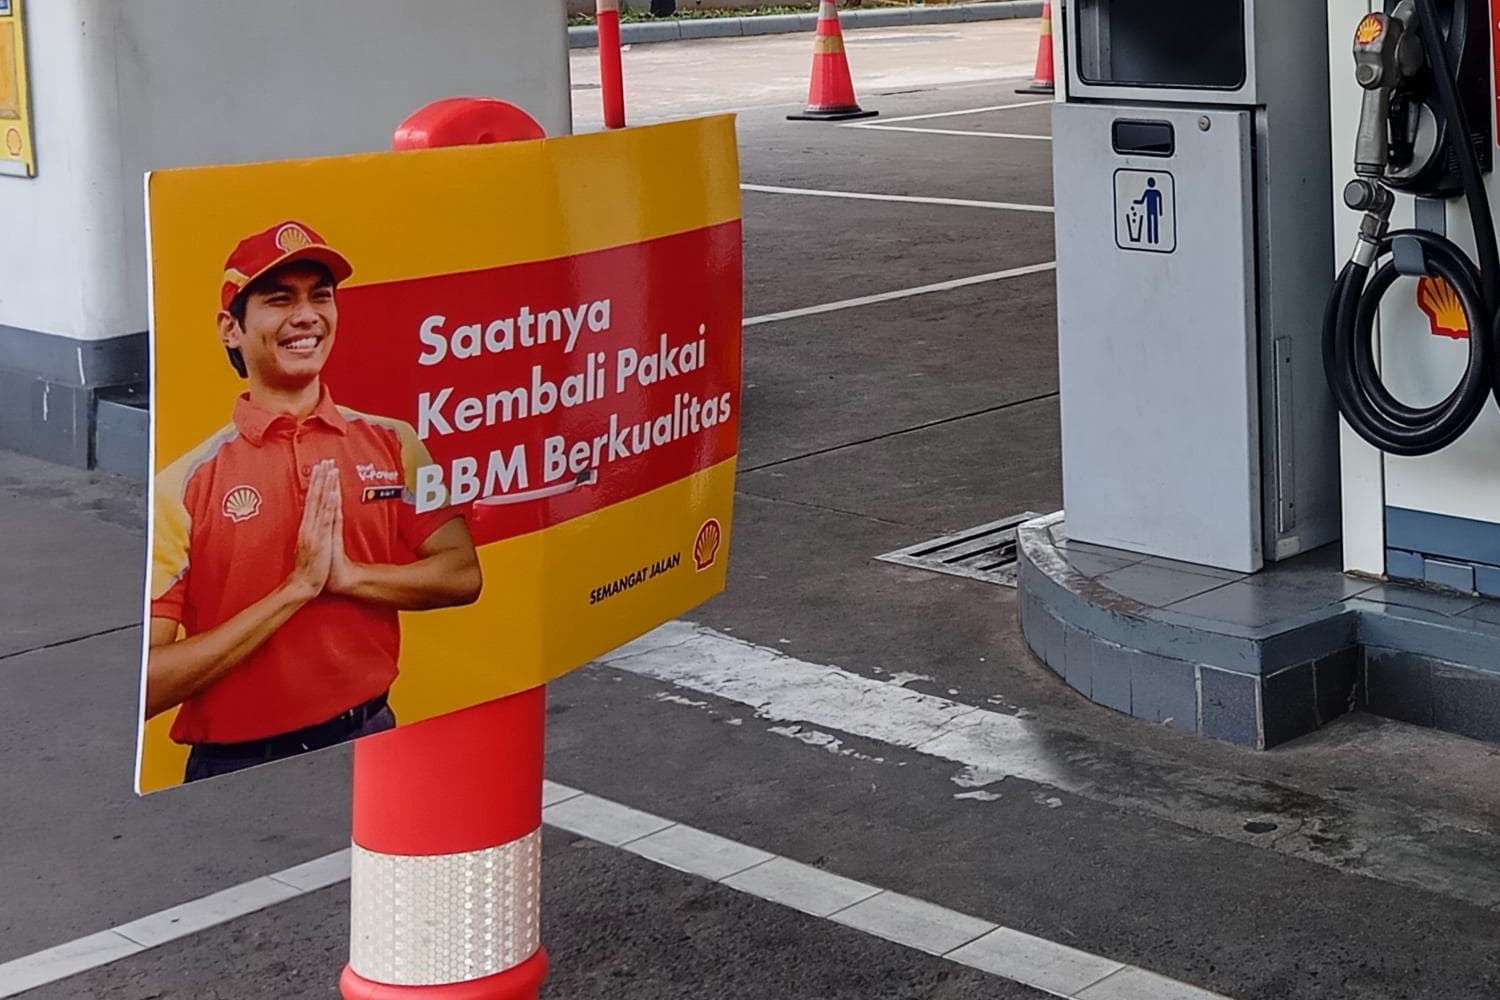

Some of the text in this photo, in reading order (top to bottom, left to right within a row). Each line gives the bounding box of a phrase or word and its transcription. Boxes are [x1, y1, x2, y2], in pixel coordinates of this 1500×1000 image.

[418, 299, 610, 365] Saatnya
[418, 324, 705, 440] Kembali Pakai
[416, 391, 731, 514] BBM Berkualitas
[590, 552, 680, 605] SEMANGAT JALAN
